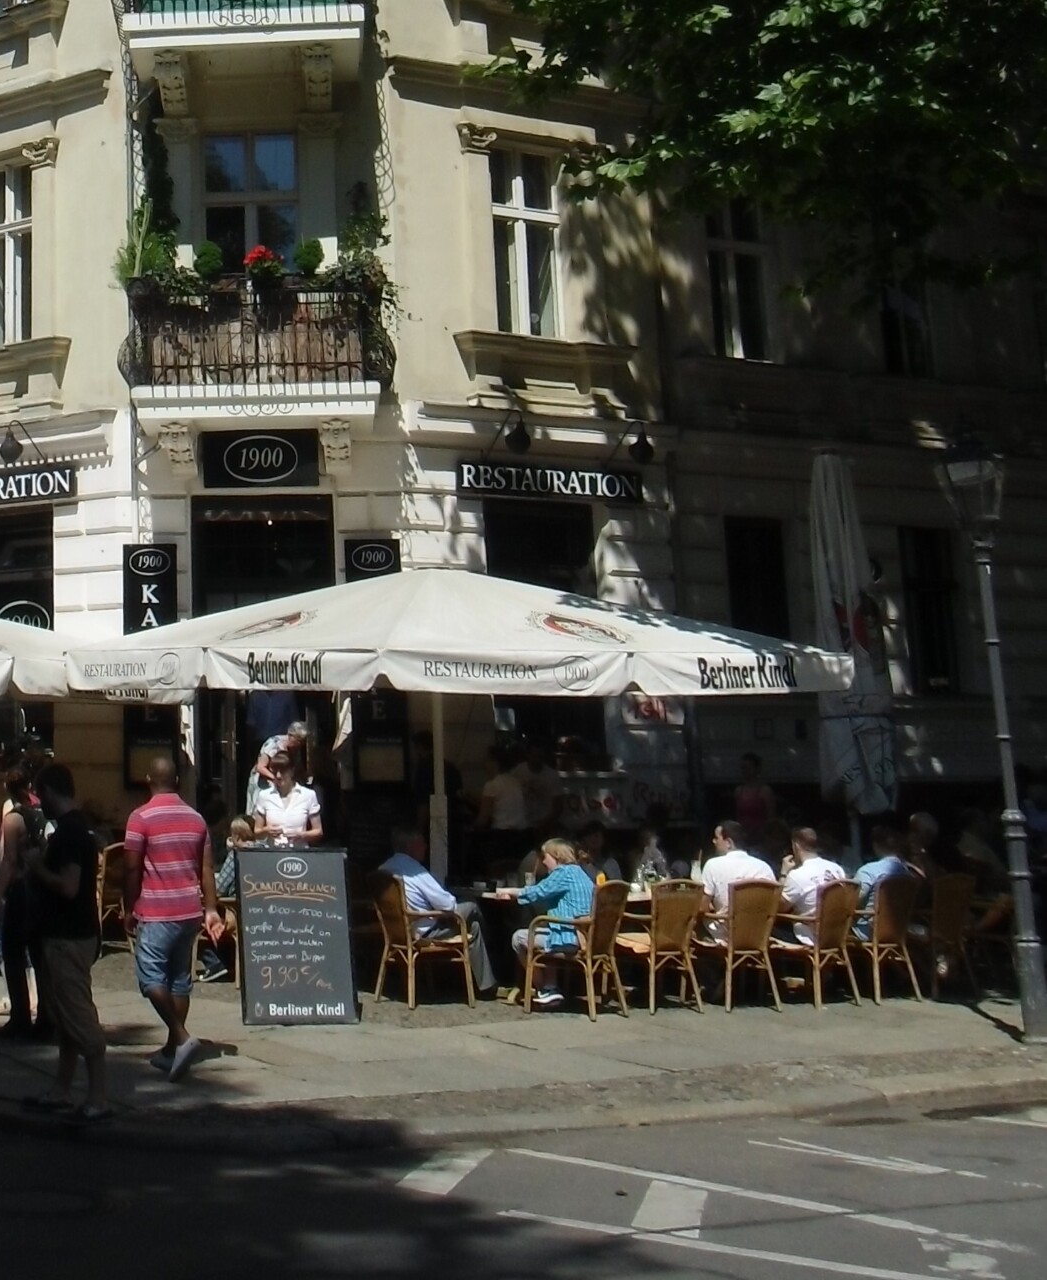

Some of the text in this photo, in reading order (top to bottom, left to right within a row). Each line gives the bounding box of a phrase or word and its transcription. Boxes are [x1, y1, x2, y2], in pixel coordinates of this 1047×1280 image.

[239, 447, 284, 470] 1900
[461, 463, 638, 498] RESTAURATION
[137, 555, 163, 569] 1900
[360, 550, 386, 564] 1900
[84, 662, 147, 677] RESTAURATION
[247, 651, 326, 684] Berliner Kindl
[423, 660, 589, 681] RESTAURATION 1900
[697, 653, 798, 689] Berliner Kindl
[283, 862, 302, 874] 1900
[269, 1001, 345, 1016] Berliner Kindl
